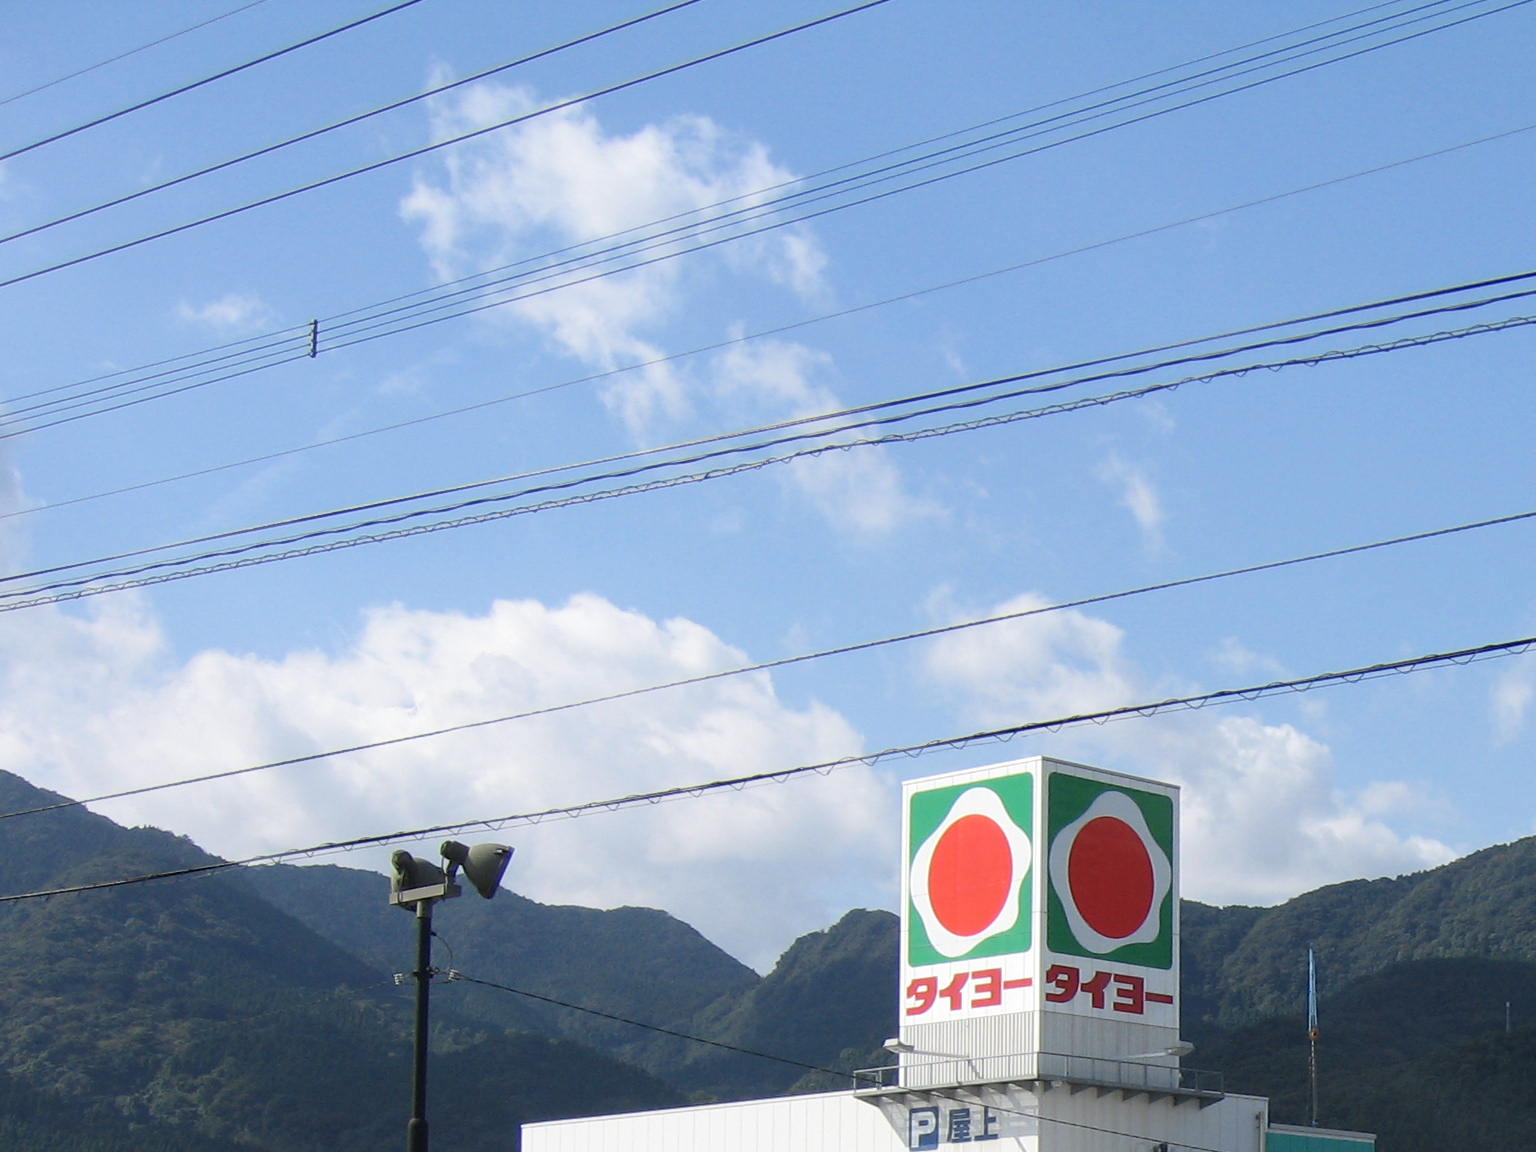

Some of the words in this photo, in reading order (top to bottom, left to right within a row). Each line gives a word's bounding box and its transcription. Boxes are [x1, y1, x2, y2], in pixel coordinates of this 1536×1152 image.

[906, 967, 1033, 1016] タイヨー
[1045, 964, 1174, 1015] タイヨー
[946, 1106, 999, 1144] 屋上
